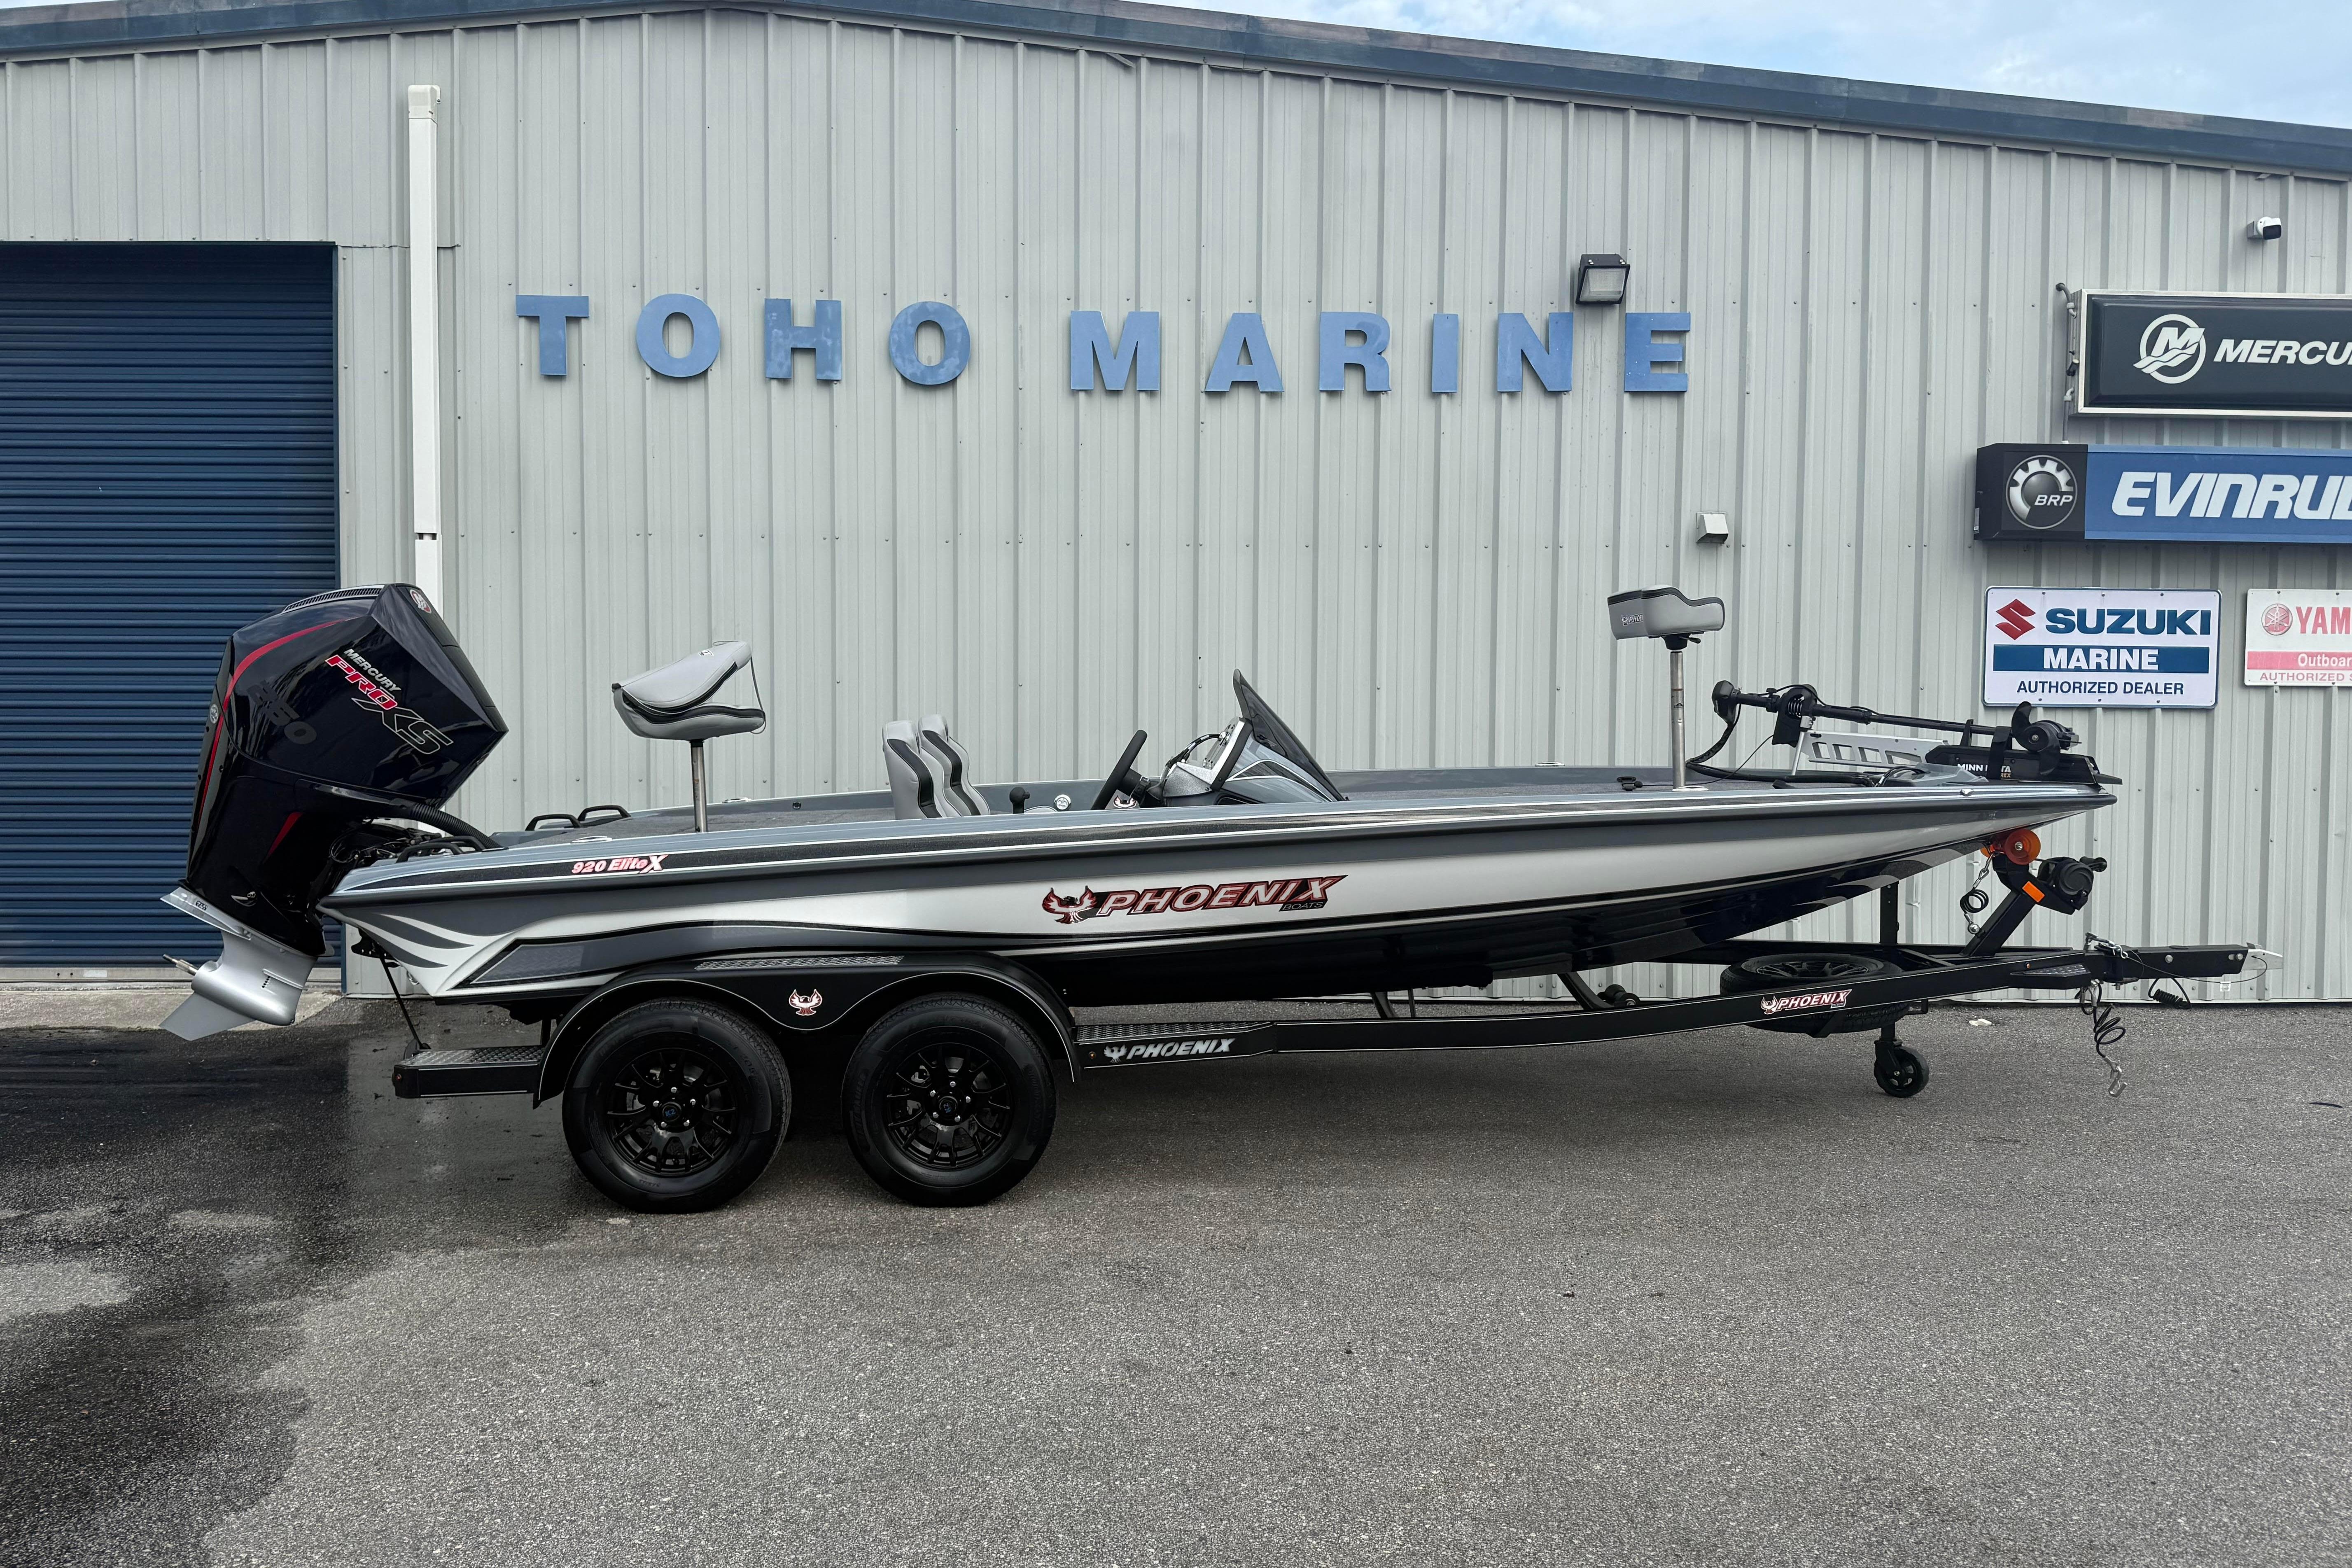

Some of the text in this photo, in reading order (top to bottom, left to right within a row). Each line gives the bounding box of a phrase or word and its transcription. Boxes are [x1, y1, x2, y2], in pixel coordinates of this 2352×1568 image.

[515, 293, 1691, 394] TOHO MARINE
[2213, 339, 2352, 366] MERCU
[2034, 495, 2073, 506] BRP
[2045, 607, 2212, 635] SUZUKI
[344, 649, 401, 691] MERCURY
[2043, 647, 2159, 671] MARINE
[325, 654, 398, 710] PRO
[2016, 681, 2184, 695] AUTHORIZED DEALER
[2260, 672, 2345, 681] AUTHORIZED
[351, 686, 454, 755] XS
[1957, 763, 1983, 772] MINN
[572, 861, 607, 874] 920
[1096, 875, 1349, 917] PHOENIX
[1282, 901, 1324, 911] BOATS
[1777, 990, 1850, 1010] PHOENIX
[1126, 1038, 1236, 1060] PHOENIX
